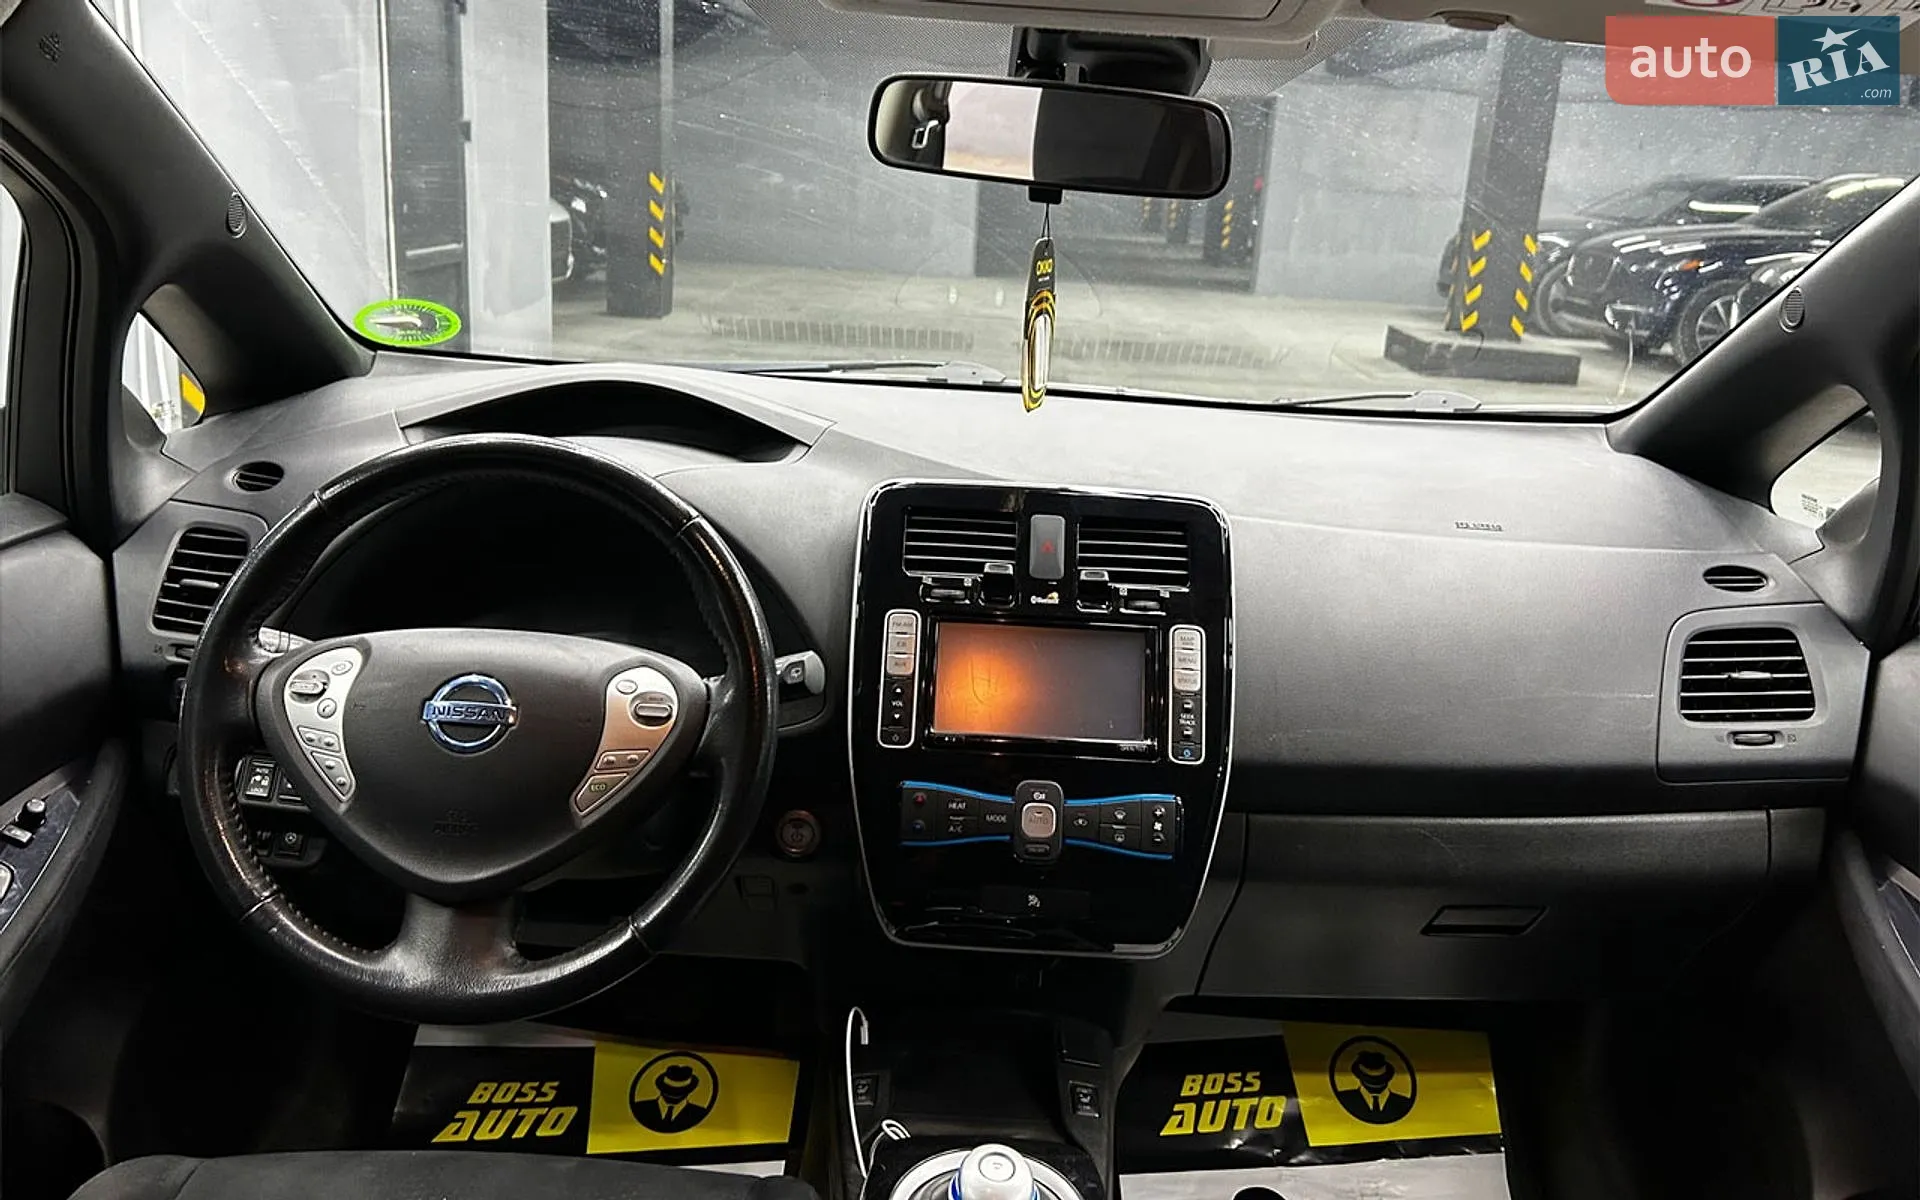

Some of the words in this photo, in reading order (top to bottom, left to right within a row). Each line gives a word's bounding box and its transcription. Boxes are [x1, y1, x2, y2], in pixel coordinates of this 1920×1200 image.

[432, 704, 507, 720] NISSAN
[590, 784, 606, 792] ECO
[948, 802, 966, 810] HEAT
[985, 814, 1008, 823] MODE
[1028, 816, 1049, 826] AUTO
[1180, 1071, 1260, 1097] BOSS
[467, 1080, 560, 1105] BOSS
[1160, 1095, 1287, 1136] AUTO
[431, 1106, 578, 1143] AUTO
